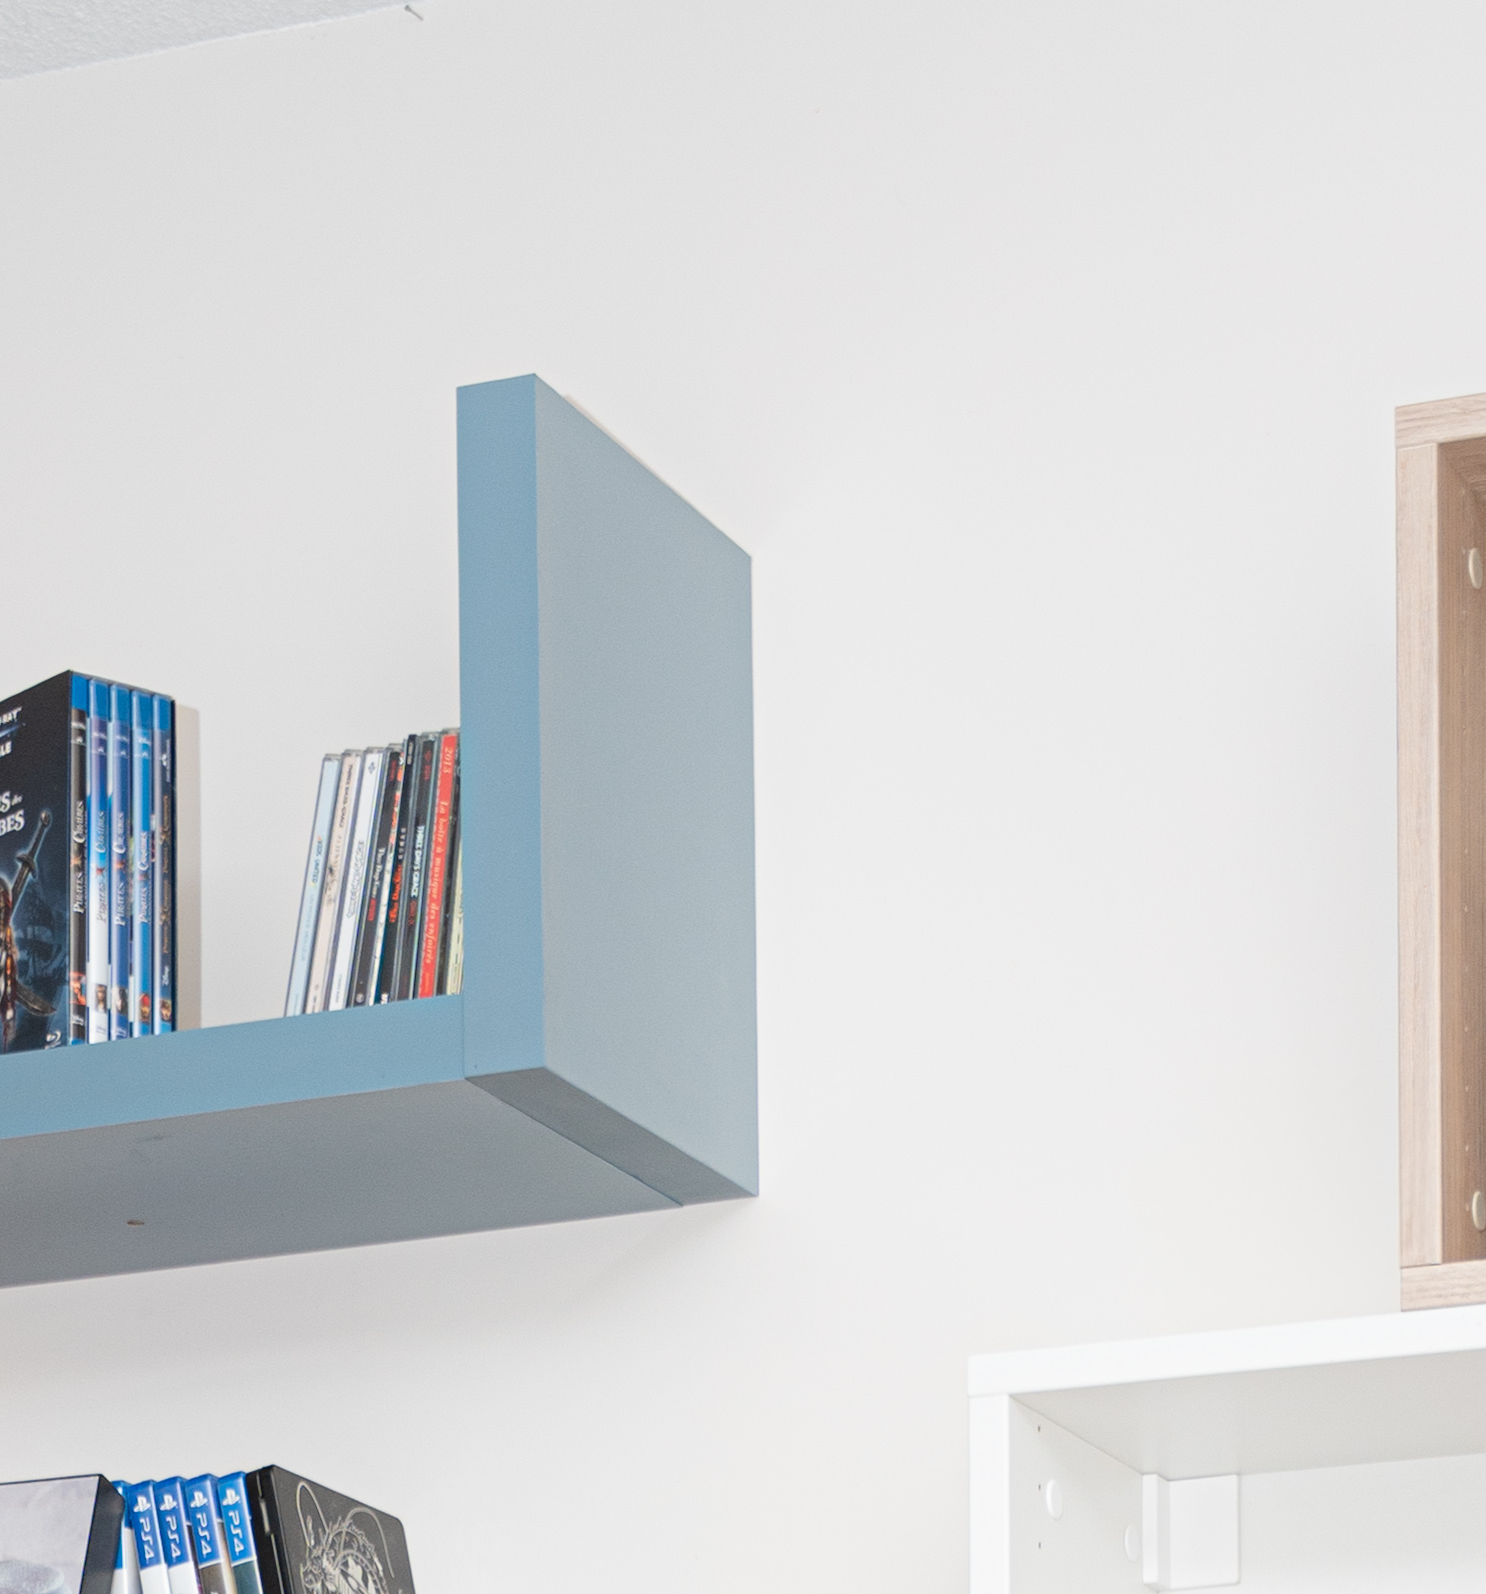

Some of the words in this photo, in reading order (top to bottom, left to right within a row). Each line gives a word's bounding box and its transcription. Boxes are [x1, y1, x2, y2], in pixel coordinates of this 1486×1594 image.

[442, 747, 453, 774] 2013
[416, 825, 425, 849] THREE
[311, 859, 322, 885] UNITED
[412, 850, 423, 871] DAYS
[410, 872, 422, 897] GRACE
[429, 857, 443, 899] musique
[429, 903, 441, 921] des
[425, 923, 438, 964] enfoirés
[139, 1518, 154, 1562] PS4
[165, 1516, 180, 1561] PS4
[196, 1513, 211, 1556] PS4
[228, 1511, 245, 1555] PS4
